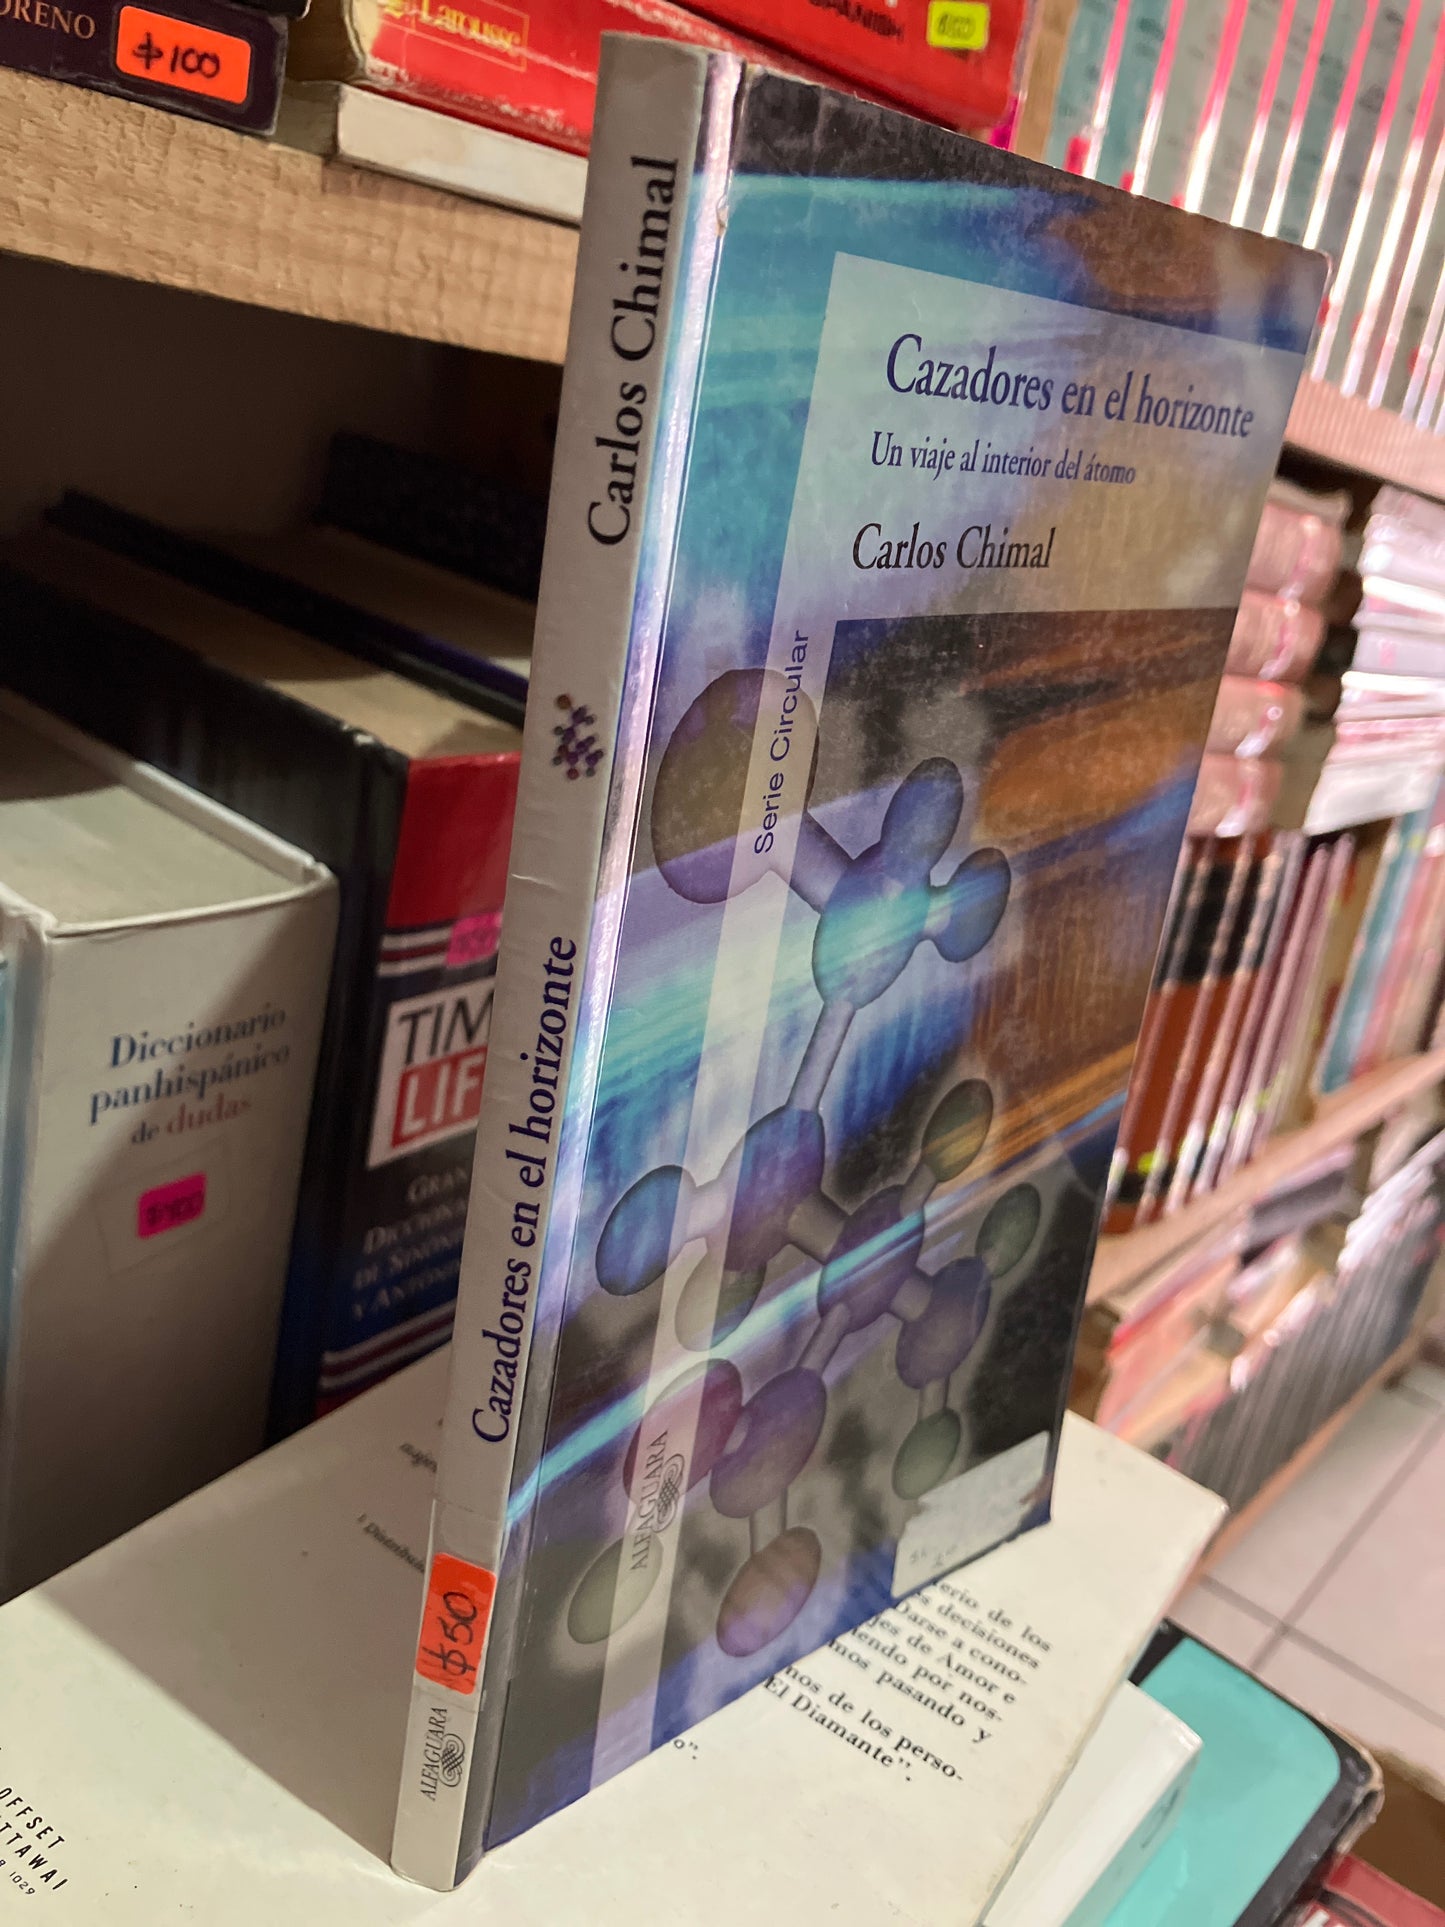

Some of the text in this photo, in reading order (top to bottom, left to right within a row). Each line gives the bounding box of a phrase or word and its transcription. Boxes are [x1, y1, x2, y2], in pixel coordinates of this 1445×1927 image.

[587, 156, 679, 546] Carlos Chimal
[886, 333, 1256, 439] Cazadores en el horizonte
[871, 430, 1137, 486] Un viaje al interior del átomo
[852, 521, 1056, 570] Carlos Chimal
[754, 630, 810, 854] Serie Circular
[112, 1002, 287, 1068] Diccionario
[91, 1042, 290, 1125] panhispánico
[132, 1092, 251, 1144] de dudas
[471, 936, 577, 1443] Cazadores en el horizonte
[630, 1429, 669, 1571] ALFAGUARA
[422, 1591, 478, 1677] $50
[933, 1573, 1051, 1653] erio de los
[937, 1602, 1040, 1671] decisiones
[765, 1674, 791, 1699] El
[907, 1634, 932, 1656] de
[936, 1655, 999, 1695] Amor
[1003, 1690, 1016, 1704] e
[911, 1663, 952, 1693] por
[958, 1688, 1003, 1723] nos-
[952, 1637, 963, 1650] a
[968, 1646, 1027, 1686] cono-
[828, 1689, 855, 1714] de
[860, 1709, 892, 1739] los
[894, 1734, 963, 1782] perso-
[875, 1670, 967, 1727] pasando
[972, 1727, 992, 1744] y
[419, 1706, 448, 1802] ALFAGUARA
[0, 1787, 65, 1849] OFFSET
[0, 1815, 68, 1891] TTAWAI
[9, 1871, 36, 1895] 1029
